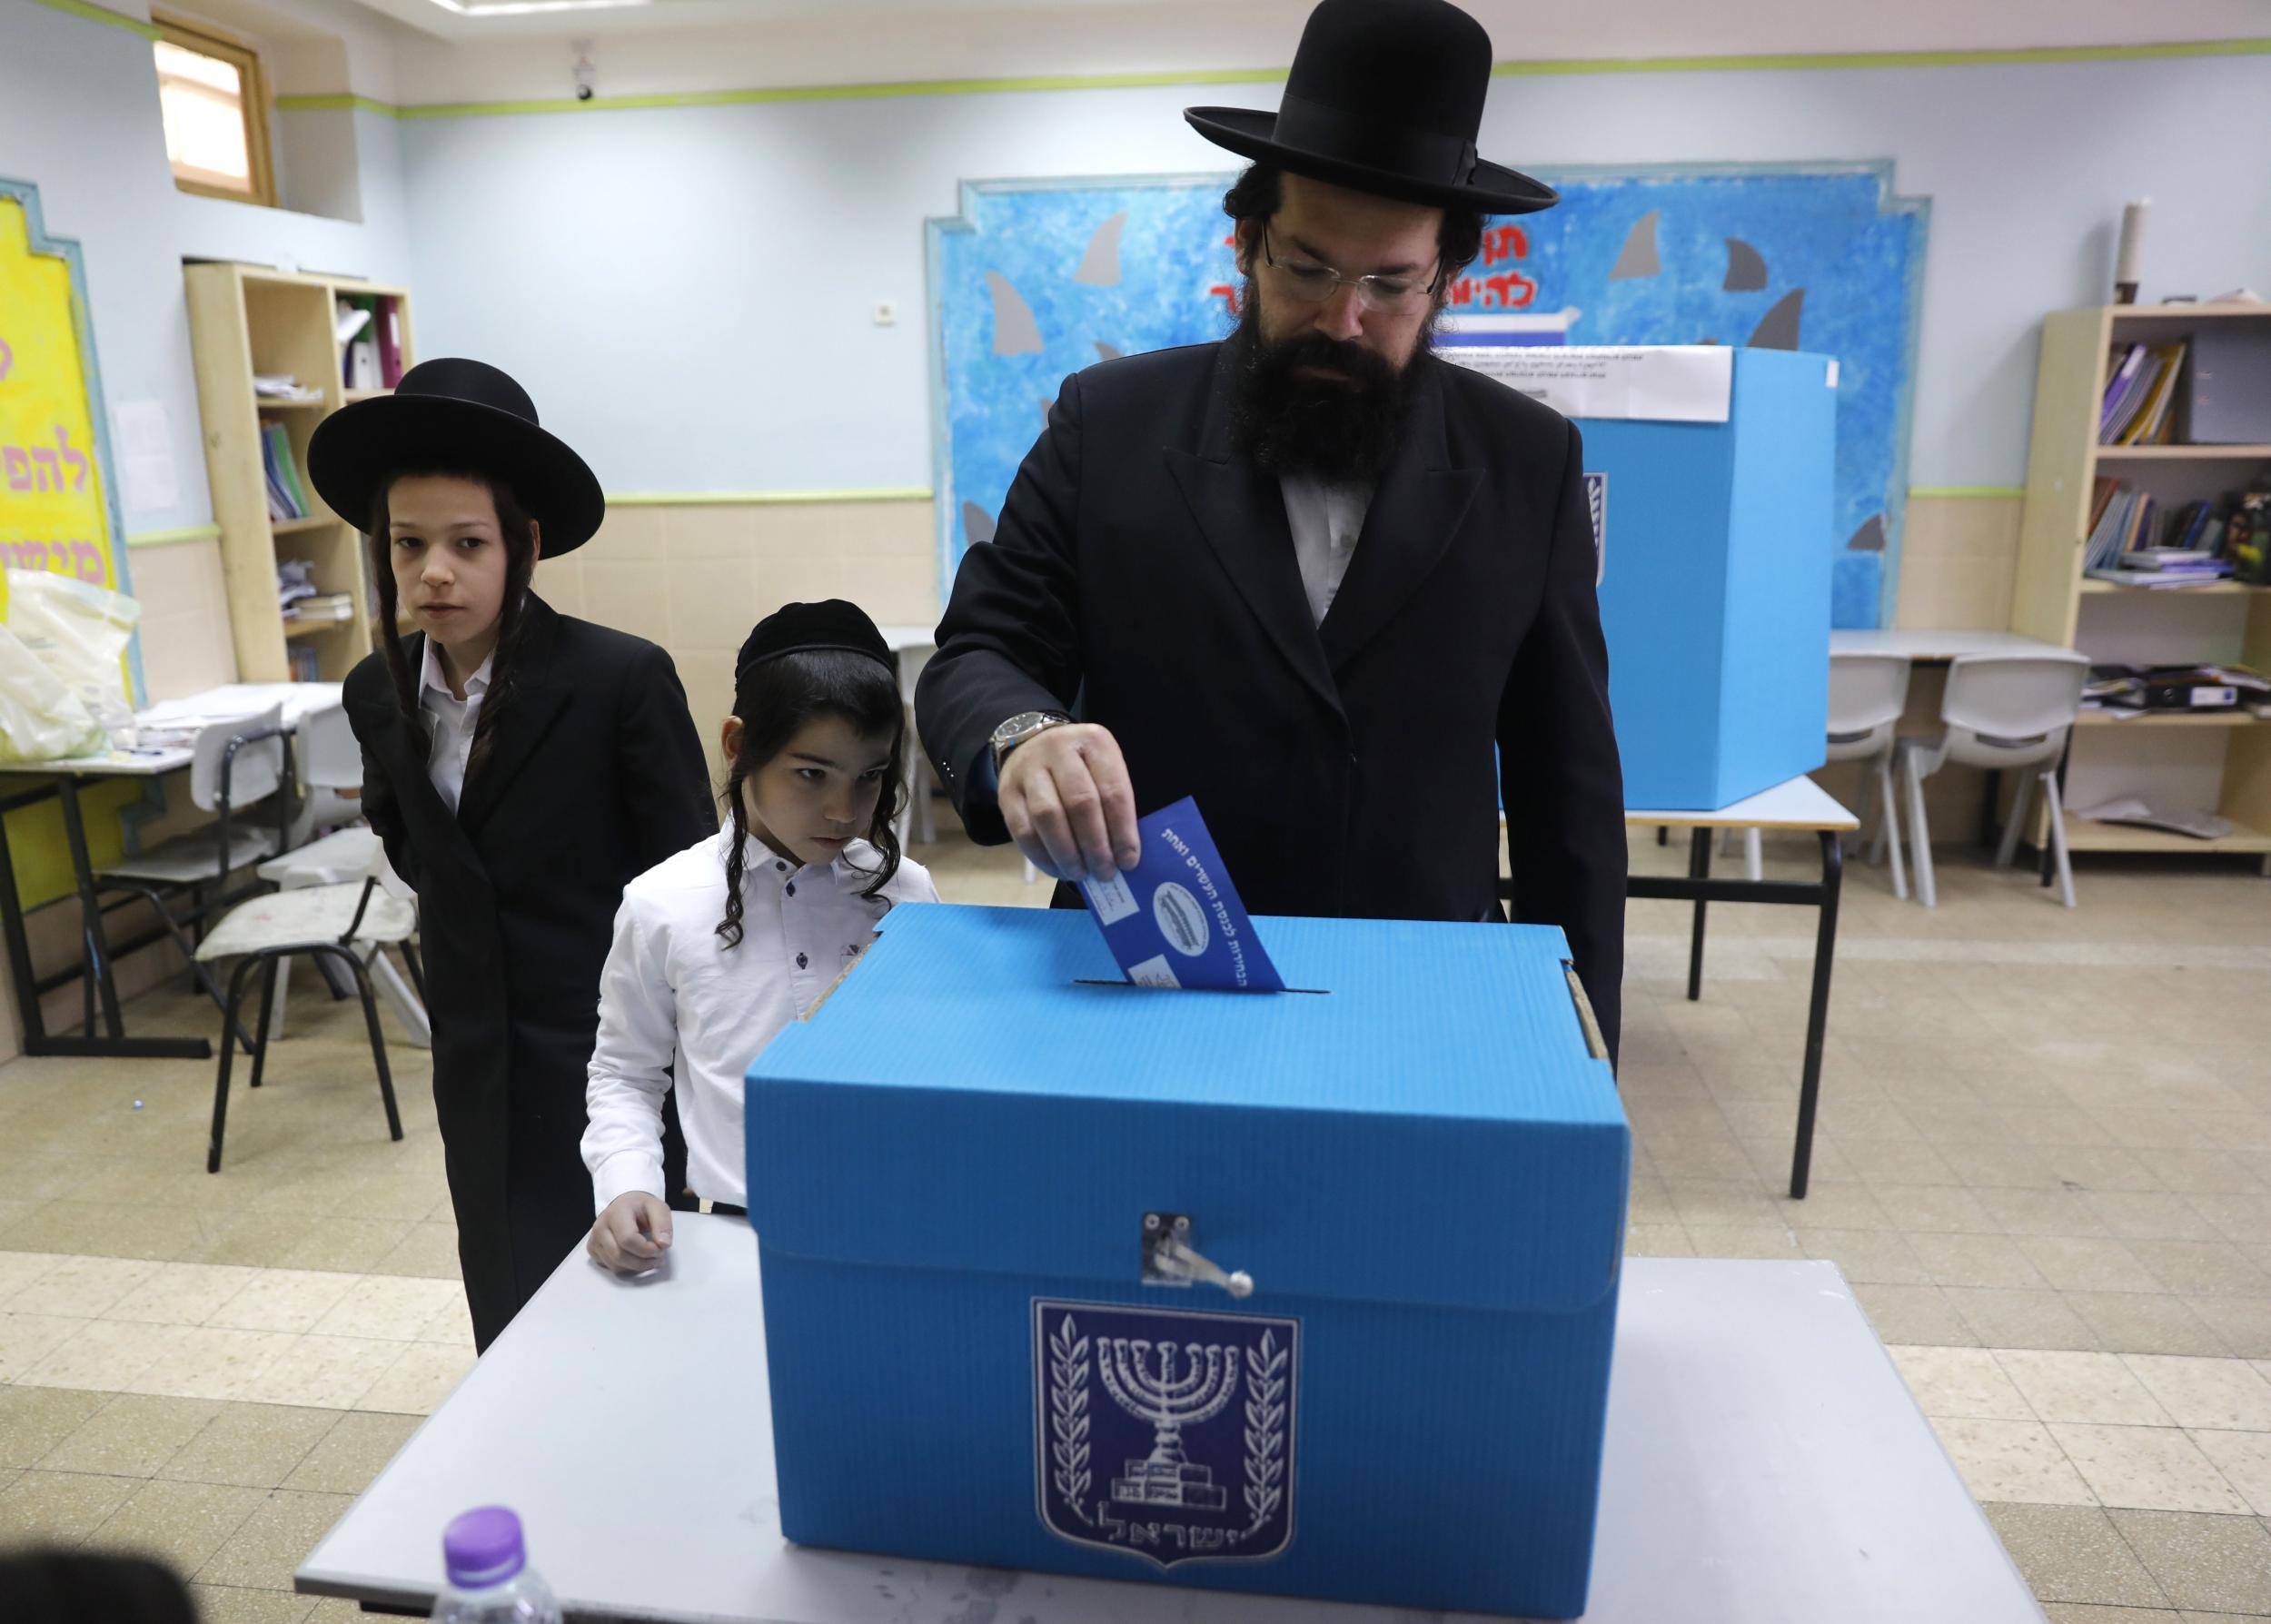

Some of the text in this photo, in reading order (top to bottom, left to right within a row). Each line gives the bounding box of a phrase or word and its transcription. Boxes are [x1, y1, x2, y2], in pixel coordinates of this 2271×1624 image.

[1161, 827, 1190, 856] ואחת
[1185, 856, 1218, 900] העשרים
[1212, 901, 1236, 936] לכנסת
[1227, 940, 1247, 988] הבחירות
[1096, 1500, 1239, 1549] ישראל
